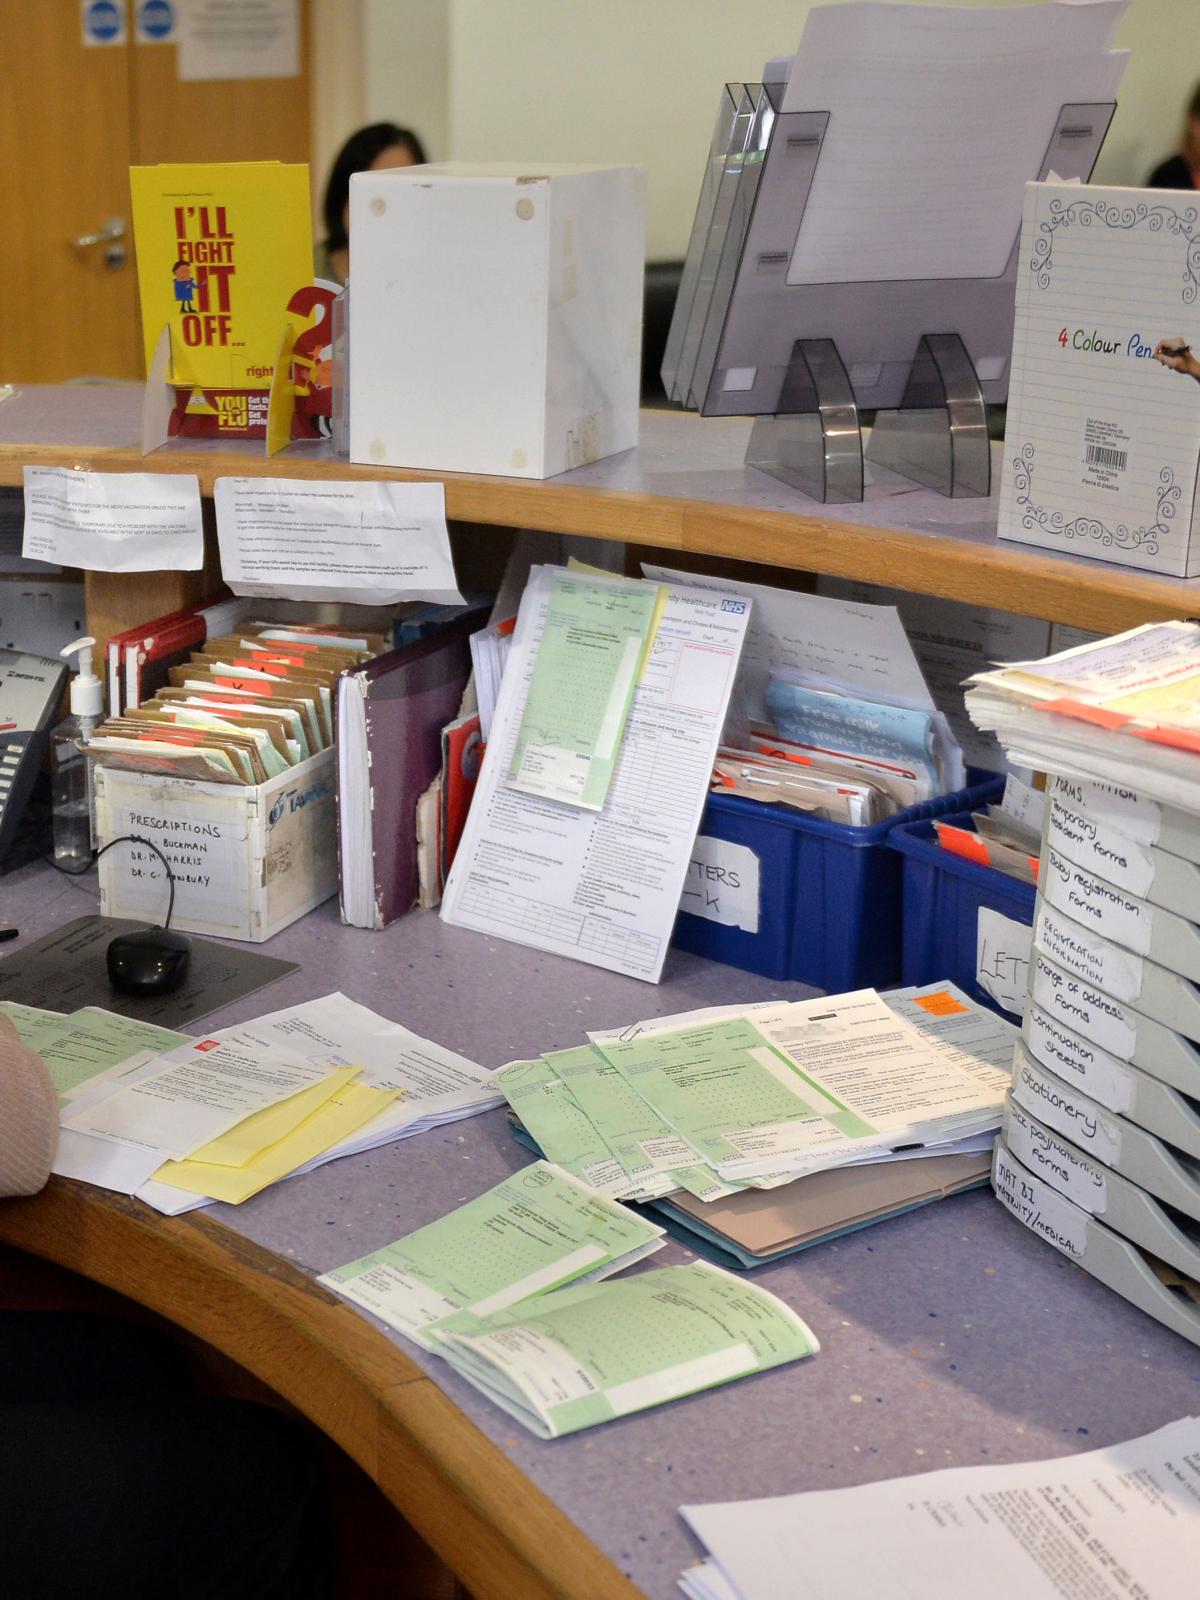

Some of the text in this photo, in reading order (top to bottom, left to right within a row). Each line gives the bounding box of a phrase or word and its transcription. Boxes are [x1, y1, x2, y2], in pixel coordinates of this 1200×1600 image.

[174, 206, 233, 239] I'LL
[178, 242, 234, 263] FIGHT
[196, 265, 235, 313] IT
[1058, 328, 1068, 347] 4
[1072, 329, 1121, 354] Colour
[215, 396, 247, 411] YOU
[218, 412, 247, 426] FLU
[721, 599, 746, 614] NHS
[129, 812, 221, 838] PRESCRIPTIONS
[163, 838, 208, 853] BUCKMAN
[1050, 852, 1139, 916] Baby registration
[1044, 917, 1104, 968] REGISTRATION
[1043, 932, 1103, 984] INFORMATION
[1020, 1067, 1097, 1139] Stationery
